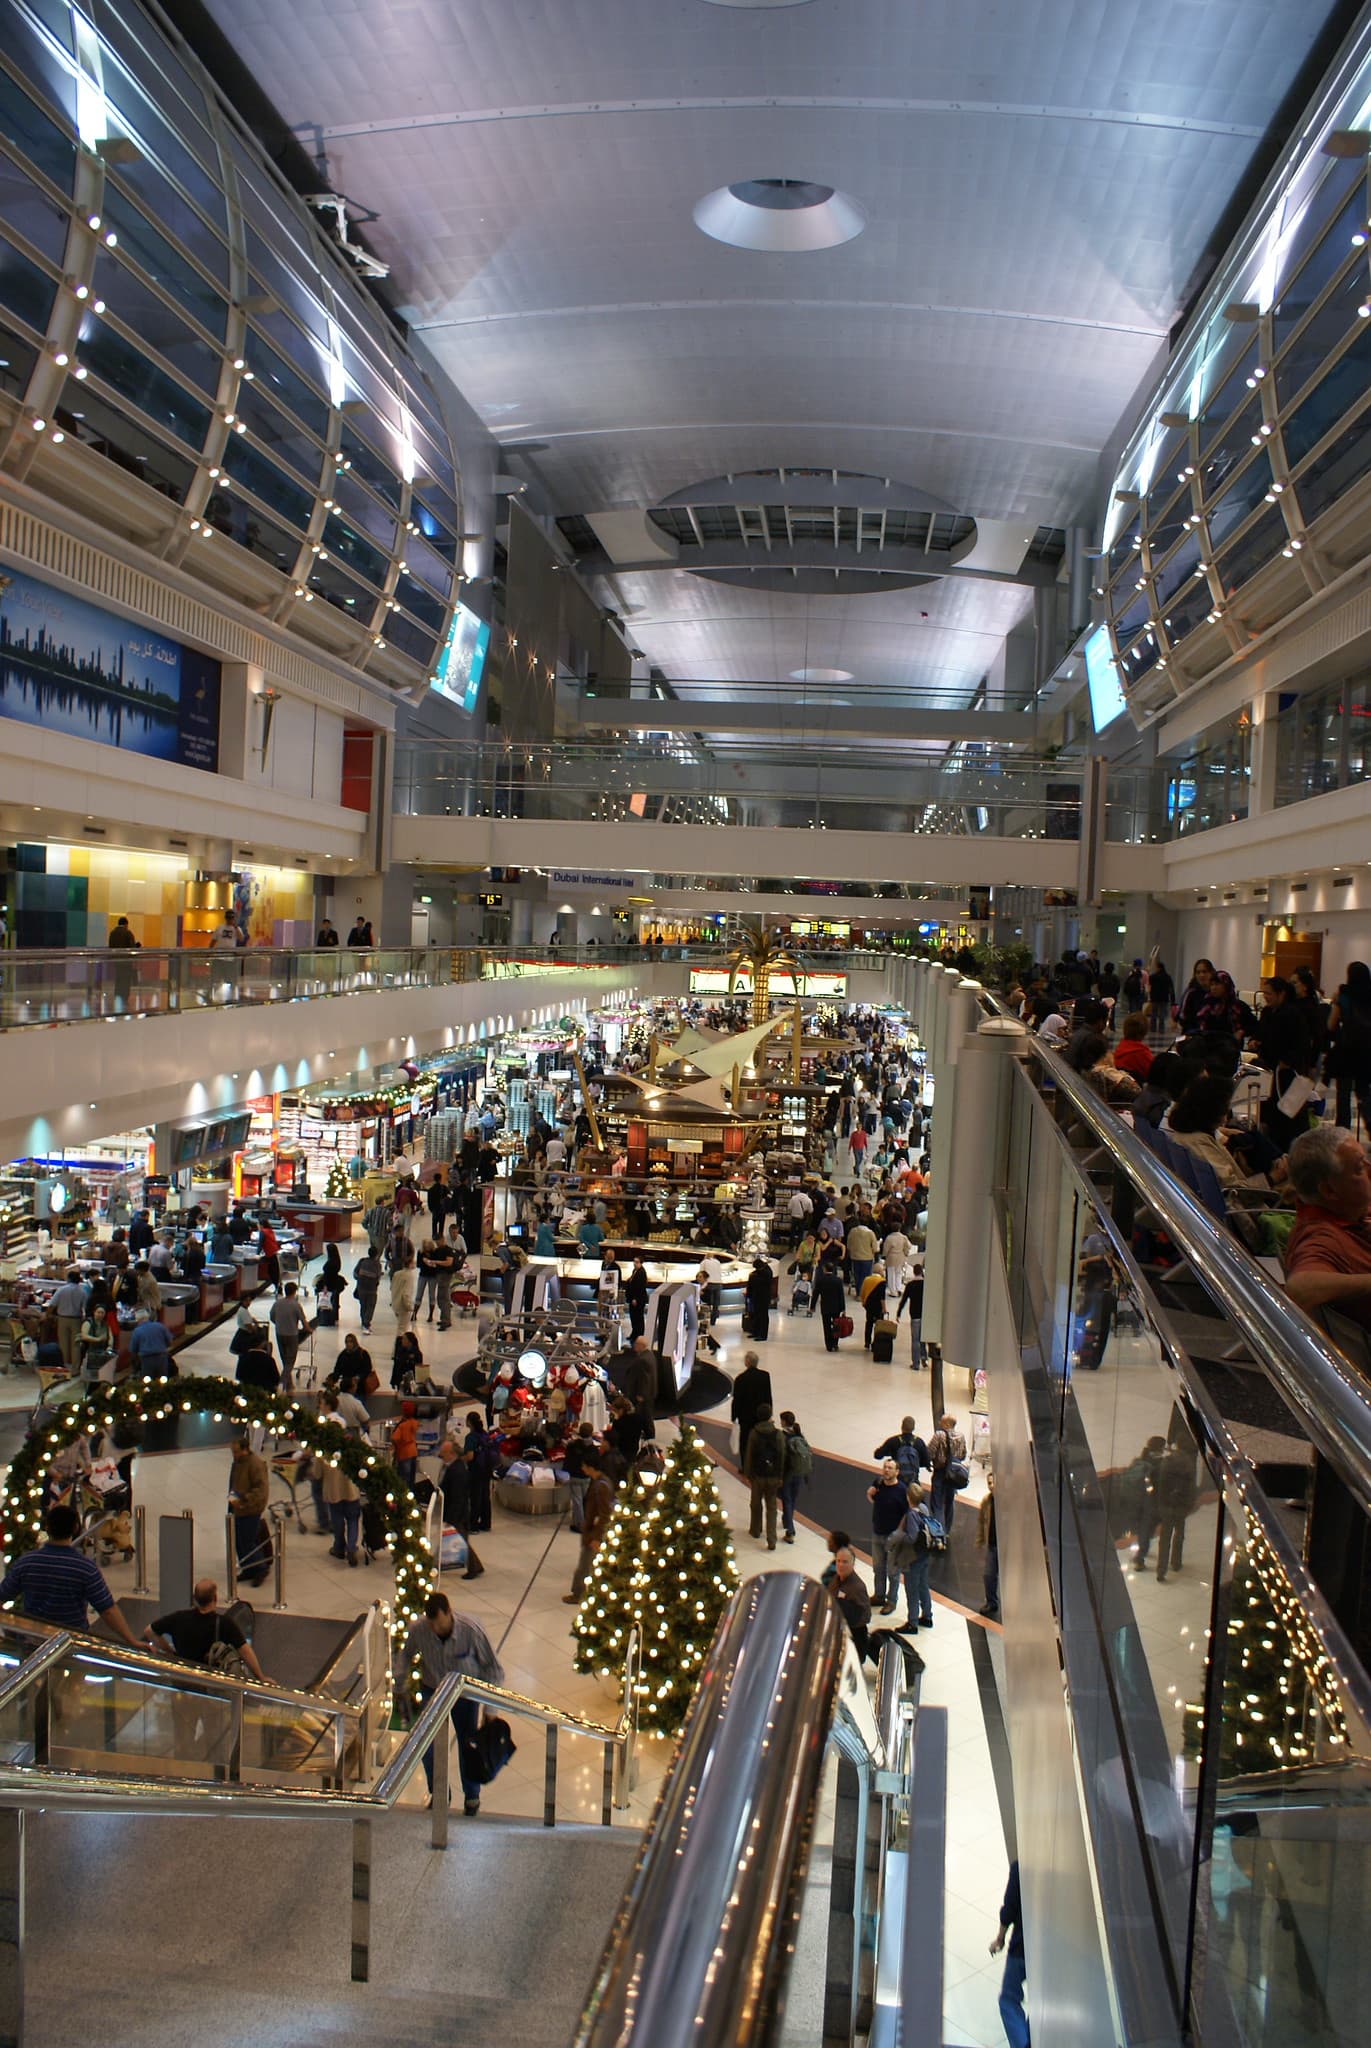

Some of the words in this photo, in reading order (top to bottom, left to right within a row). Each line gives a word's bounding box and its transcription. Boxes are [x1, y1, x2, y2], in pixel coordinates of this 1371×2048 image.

[553, 872, 579, 883] Dubai
[582, 874, 622, 887] International
[486, 894, 495, 905] 15
